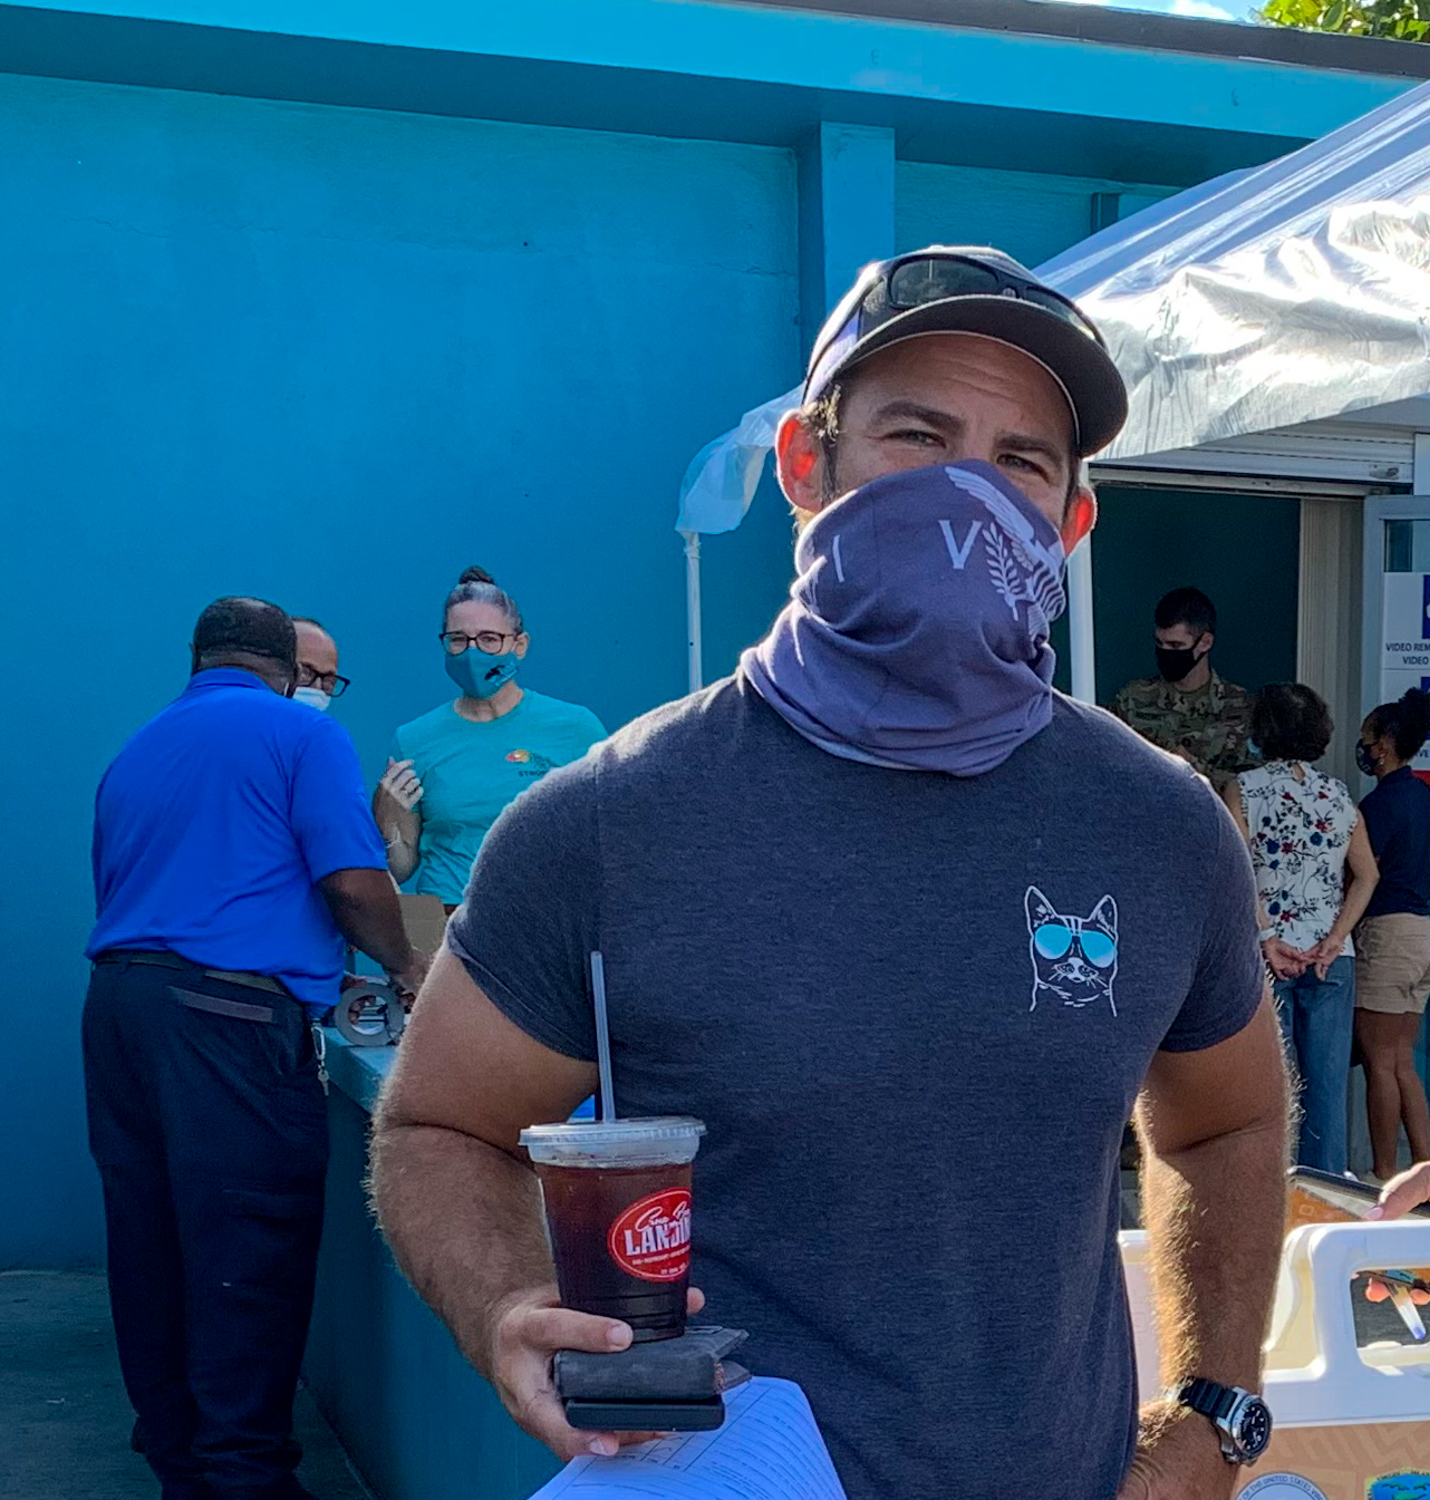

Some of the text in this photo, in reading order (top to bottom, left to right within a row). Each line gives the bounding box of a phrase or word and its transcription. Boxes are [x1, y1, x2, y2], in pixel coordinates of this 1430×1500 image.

[939, 519, 983, 570] V
[1386, 643, 1411, 652] VIDEO
[1402, 656, 1428, 665] VIDEO
